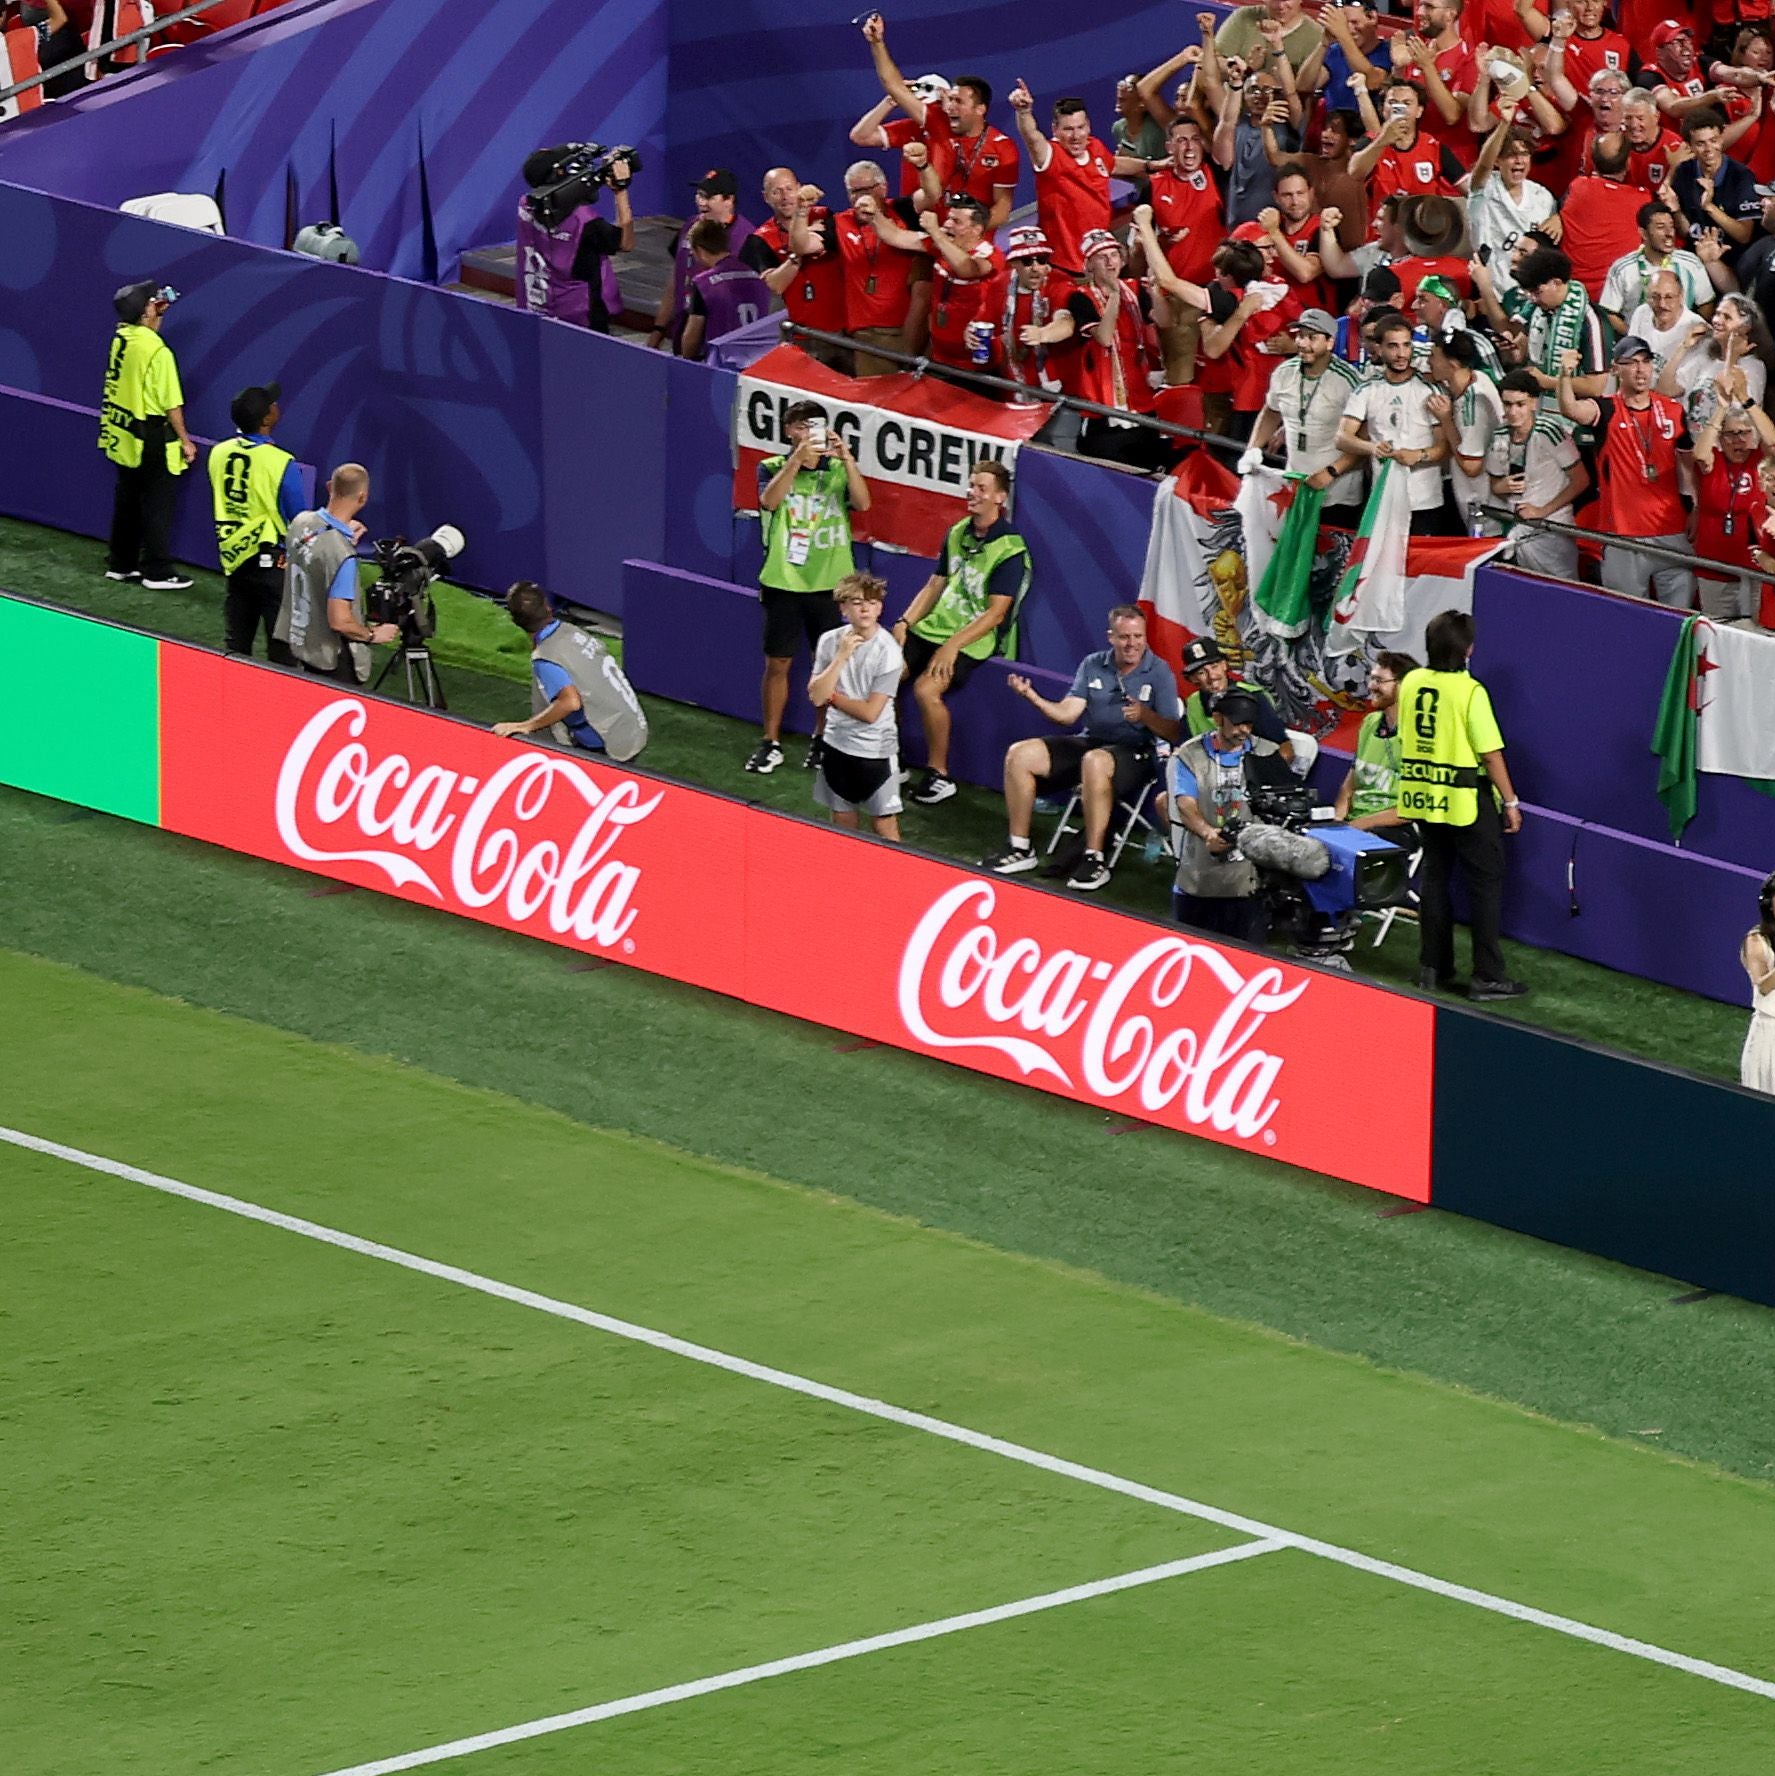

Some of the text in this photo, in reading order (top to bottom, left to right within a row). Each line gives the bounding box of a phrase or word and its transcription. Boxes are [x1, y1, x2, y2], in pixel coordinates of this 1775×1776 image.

[1502, 231, 1518, 250] 8
[751, 390, 863, 461] GLG
[275, 698, 665, 951] Coca-Cola
[898, 879, 1311, 1140] Coca-Cola
